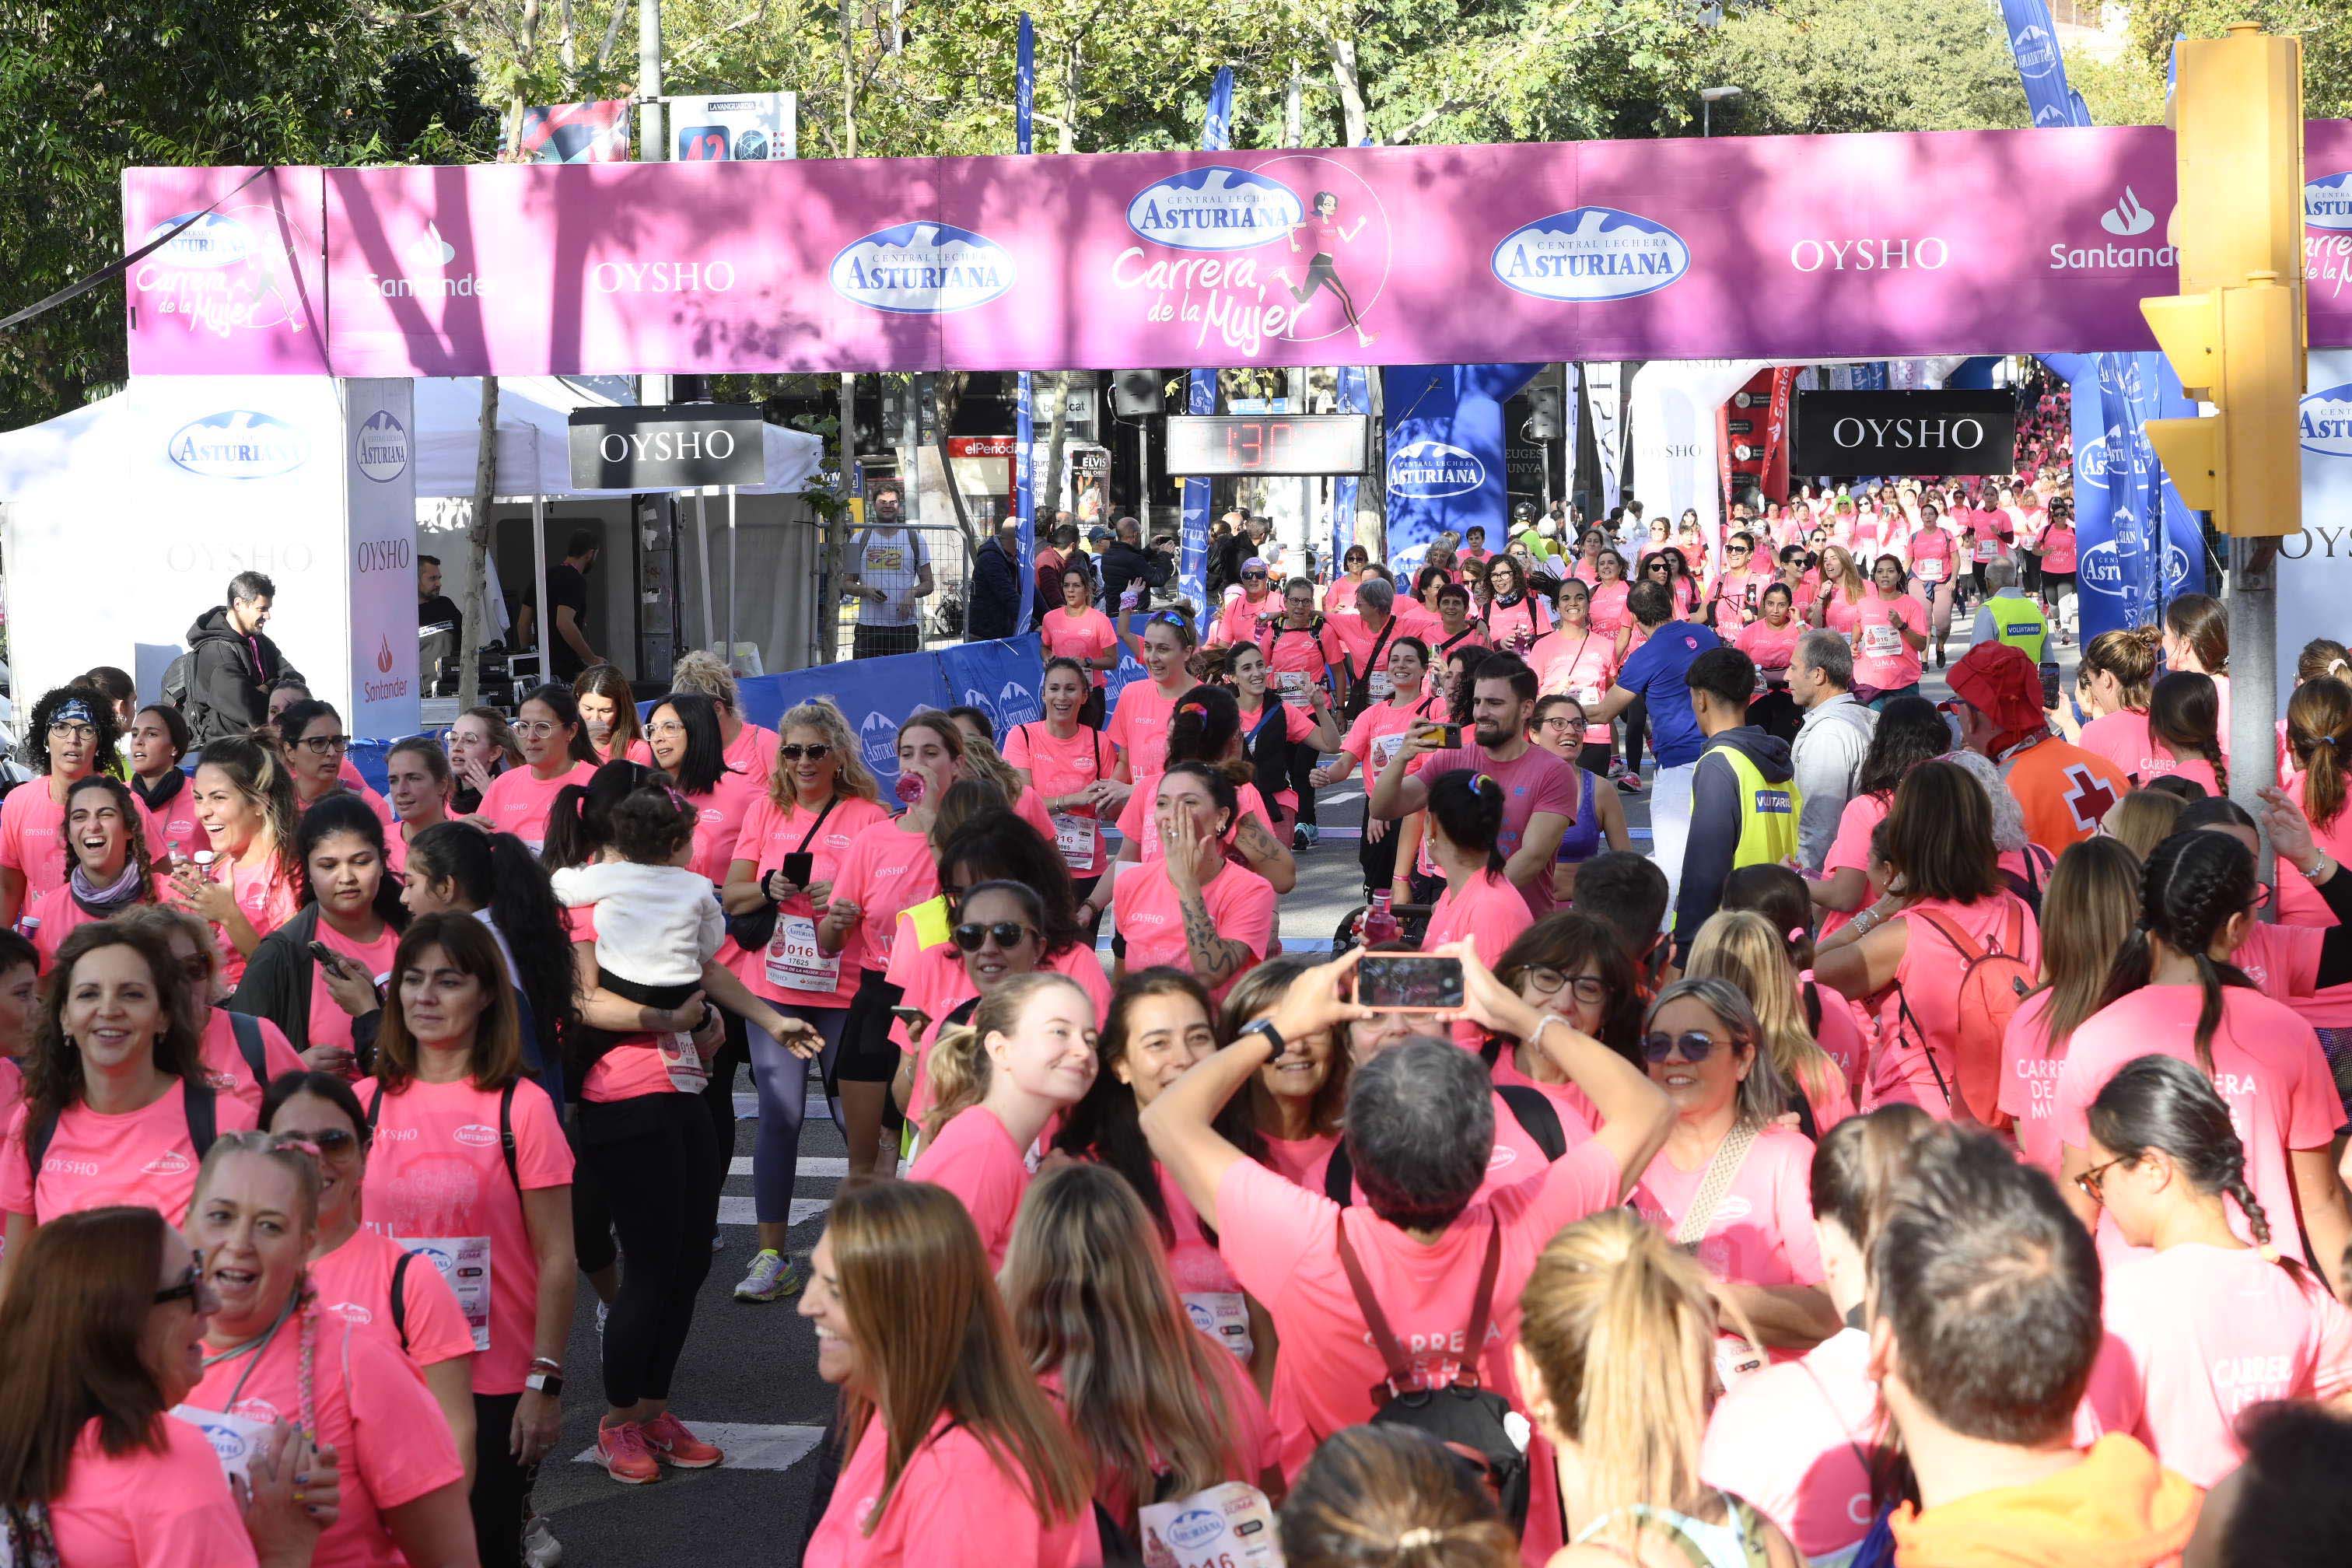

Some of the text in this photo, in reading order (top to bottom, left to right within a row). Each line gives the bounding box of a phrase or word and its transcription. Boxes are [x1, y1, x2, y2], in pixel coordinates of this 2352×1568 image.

[1167, 194, 1282, 205] CENTRAL LECHE
[1140, 198, 1290, 230] ASTURIANA
[1537, 238, 1668, 250] CENTRAL LECHERA
[1790, 237, 1949, 273] OYSHO
[872, 254, 930, 263] CENTRAL
[1112, 247, 1258, 289] Carrera
[1507, 243, 1674, 278] ASTURIANA
[2322, 257, 2336, 280] la
[592, 261, 735, 293] OYSHO
[846, 256, 1001, 289] ASTURIANA
[366, 273, 487, 299] Santande
[159, 299, 176, 313] de
[1147, 285, 1311, 357] de la Mujer
[1832, 418, 1984, 450] OYSHO
[360, 437, 404, 465] ASTURIANA
[600, 429, 735, 464] OYSHO
[1082, 457, 1106, 467] ELVIS
[1390, 464, 1478, 486] ASTURIANA
[358, 538, 410, 574] OYSHO
[2007, 625, 2040, 634] VOLUNTARIS
[365, 677, 408, 705] Santander
[1002, 706, 1038, 730] ASTURIANA
[25, 828, 54, 838] OYSHO
[770, 831, 801, 842] OYSHO
[875, 866, 908, 877] OYSHO
[787, 944, 814, 957] 016
[789, 957, 810, 967] 17625
[2031, 1080, 2054, 1100] DE
[459, 1130, 496, 1142] ASTURIANA
[45, 1158, 98, 1177] OYSHO
[1363, 1320, 1502, 1355] CRREA
